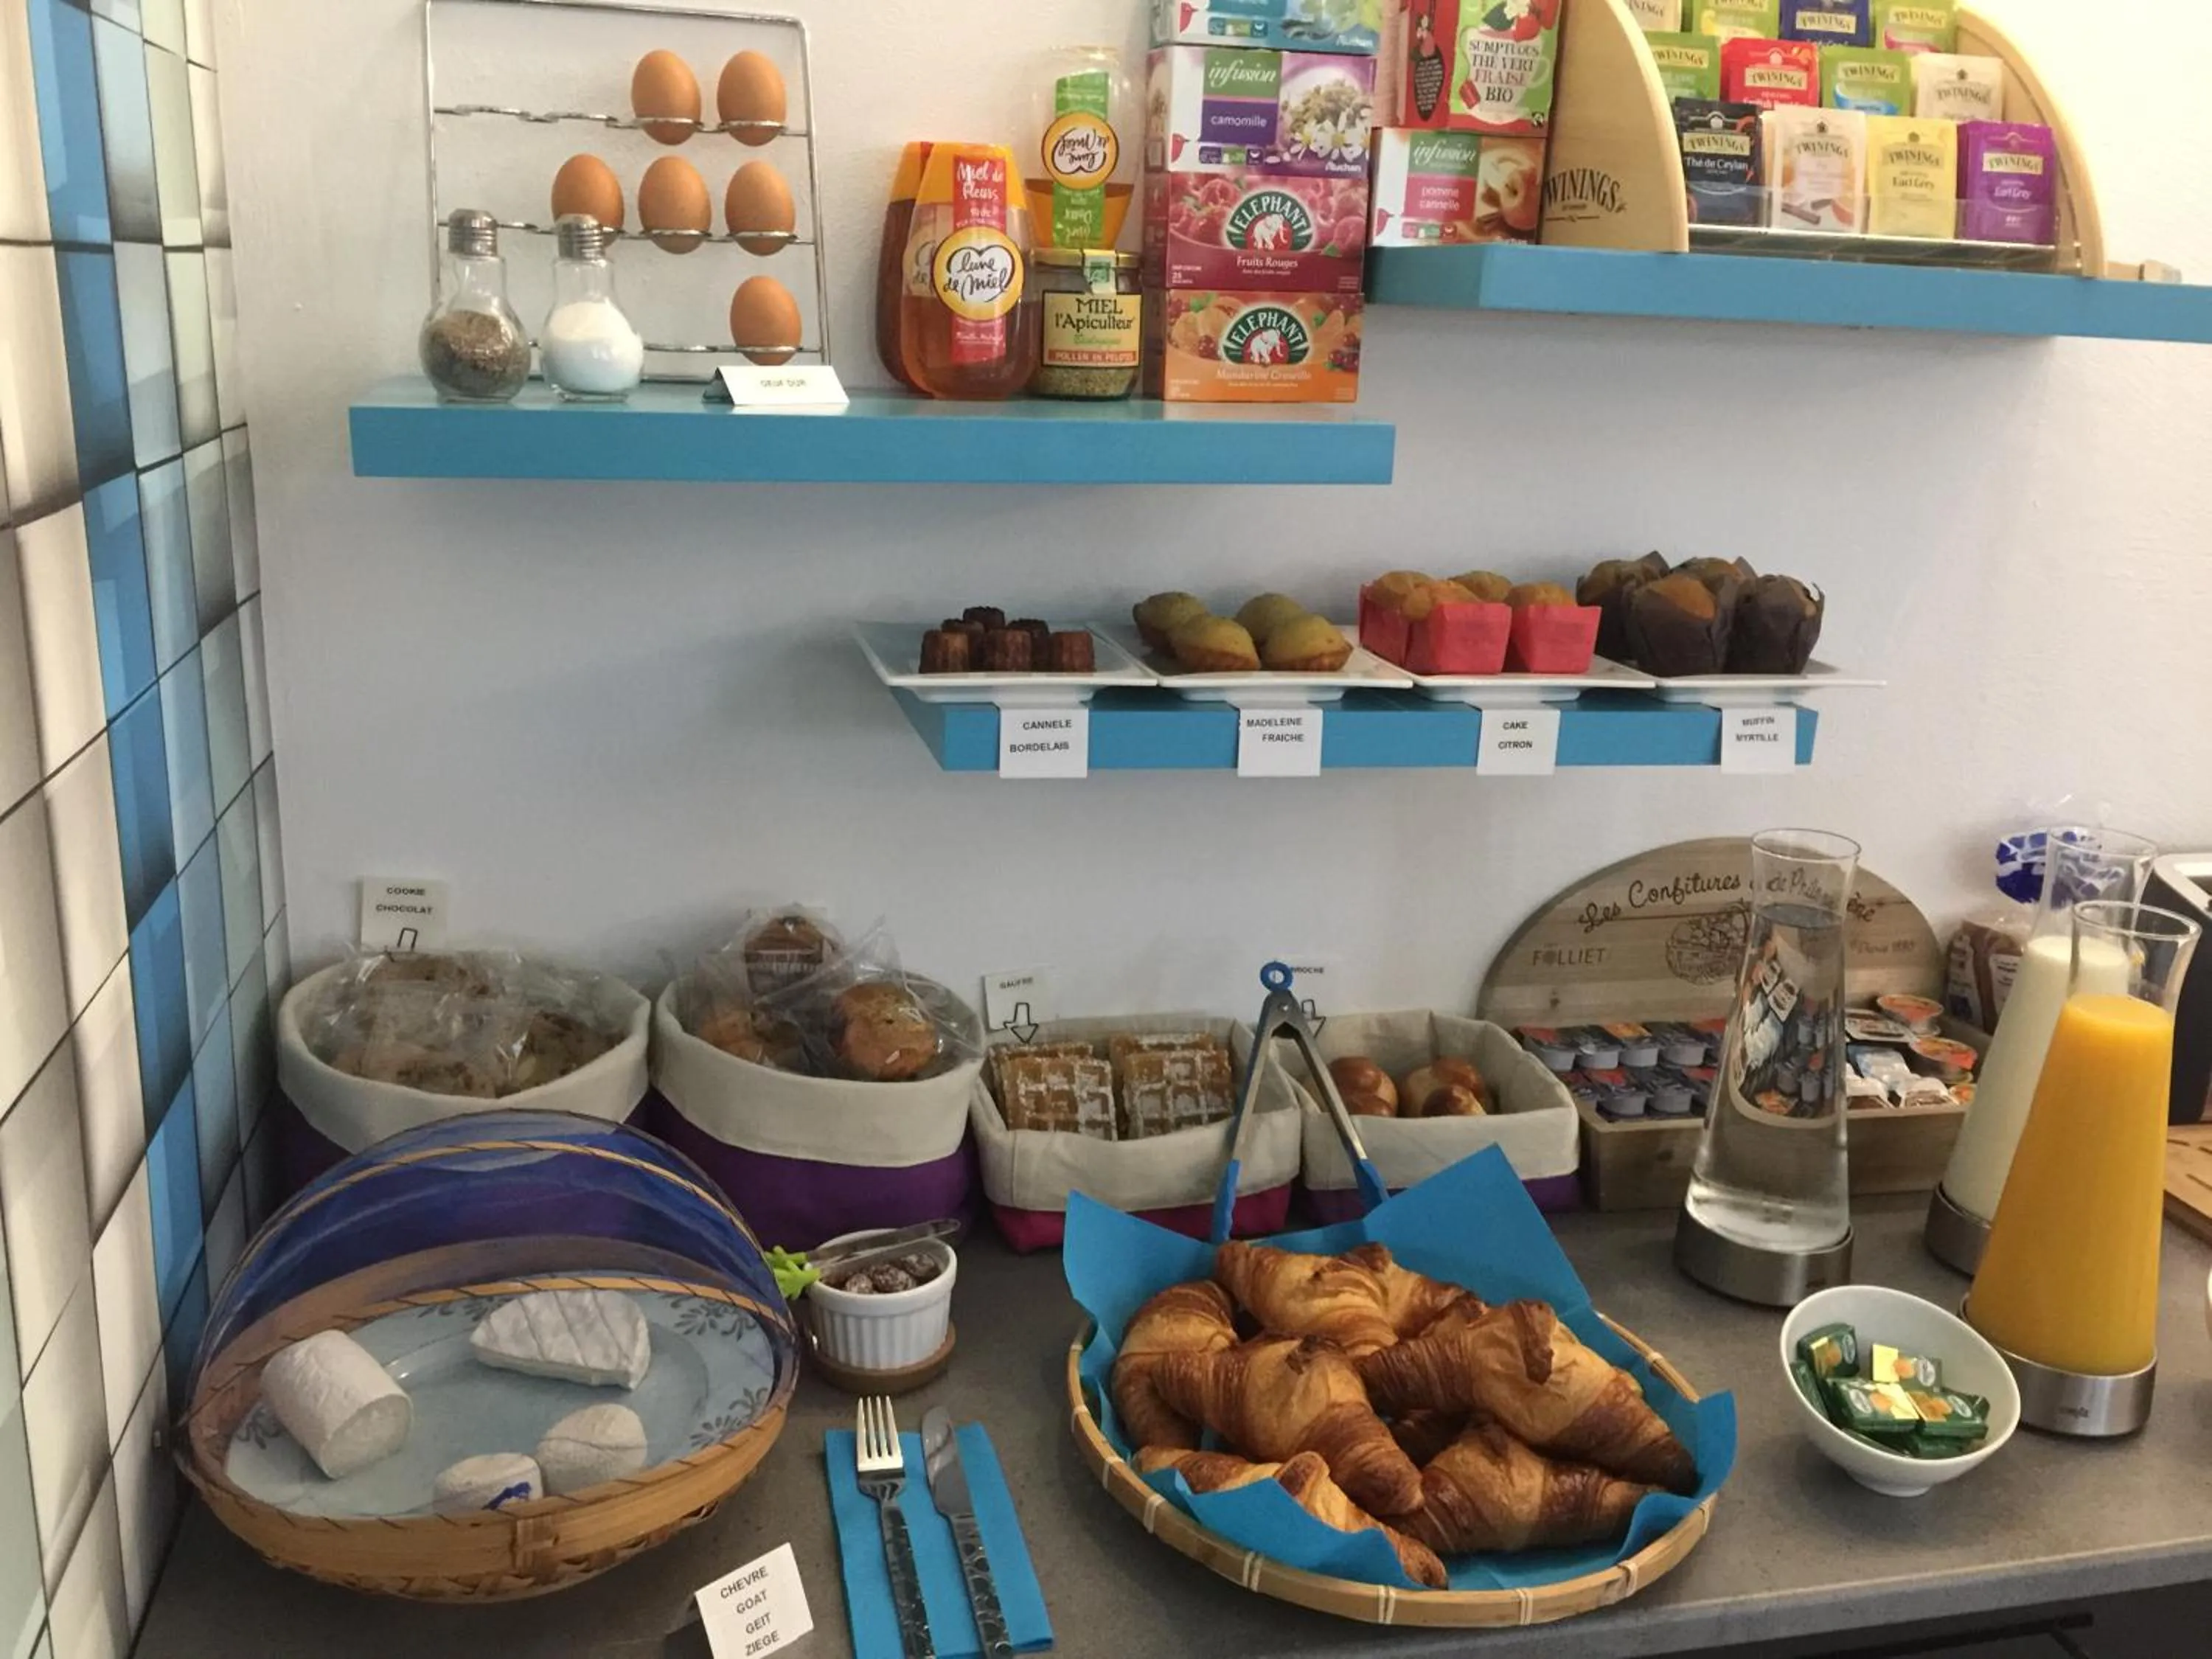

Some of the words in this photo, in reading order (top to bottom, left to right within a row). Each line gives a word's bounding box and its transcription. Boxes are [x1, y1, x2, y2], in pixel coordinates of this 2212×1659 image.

[1801, 15, 1851, 30] TWININGS
[1894, 10, 1942, 27] TWININGS
[1337, 35, 1373, 47] Auchan
[1501, 57, 1535, 72] VERT
[1653, 49, 1703, 66] WININGS
[1208, 59, 1277, 88] infusion
[1475, 69, 1525, 85] FRAISE
[1751, 71, 1802, 87] TWININGS
[1843, 64, 1895, 81] TWININGS
[1486, 86, 1514, 102] BIO
[1936, 86, 1989, 105] TWININGS
[1211, 116, 1267, 128] camomille
[1689, 136, 1745, 152] TWININGS
[1795, 141, 1849, 159] TWININGS
[1413, 139, 1477, 166] infusion
[1888, 150, 1940, 167] TWININGS
[1325, 161, 1361, 172] Auchan
[1989, 156, 2040, 173] TWININGS
[1422, 187, 1459, 199] pomme
[1545, 169, 1621, 213] WININGS
[1234, 195, 1308, 230] ELEPHANT
[1419, 200, 1460, 211] cannelle
[958, 251, 998, 274] lune
[1237, 256, 1264, 267] Fruits
[1265, 256, 1298, 270] Rouges
[1076, 297, 1124, 314] MIEL
[1055, 313, 1135, 333] l'Apiculteur
[1231, 312, 1303, 347] ELEPHANT
[1023, 719, 1072, 731] CANNELE
[1246, 717, 1303, 728] MADELEINE
[1503, 720, 1528, 730] CAKE
[1742, 717, 1775, 726] MUFFIN
[1262, 733, 1304, 743] FRAICHE
[1498, 740, 1533, 750] CITRON
[1735, 733, 1779, 742] MYRTILLE
[1009, 741, 1069, 754] BORDELAIS
[386, 886, 425, 897] COOKIE
[375, 903, 433, 915] CHOCOLAT
[1578, 901, 1621, 933] Les
[1628, 872, 1742, 908] Confitures
[1533, 947, 1607, 967] FOLLIET
[720, 1565, 769, 1599] CHEVRE
[736, 1589, 768, 1615] GOAT
[745, 1612, 771, 1635] GEIT
[745, 1630, 780, 1657] ZIEGE
